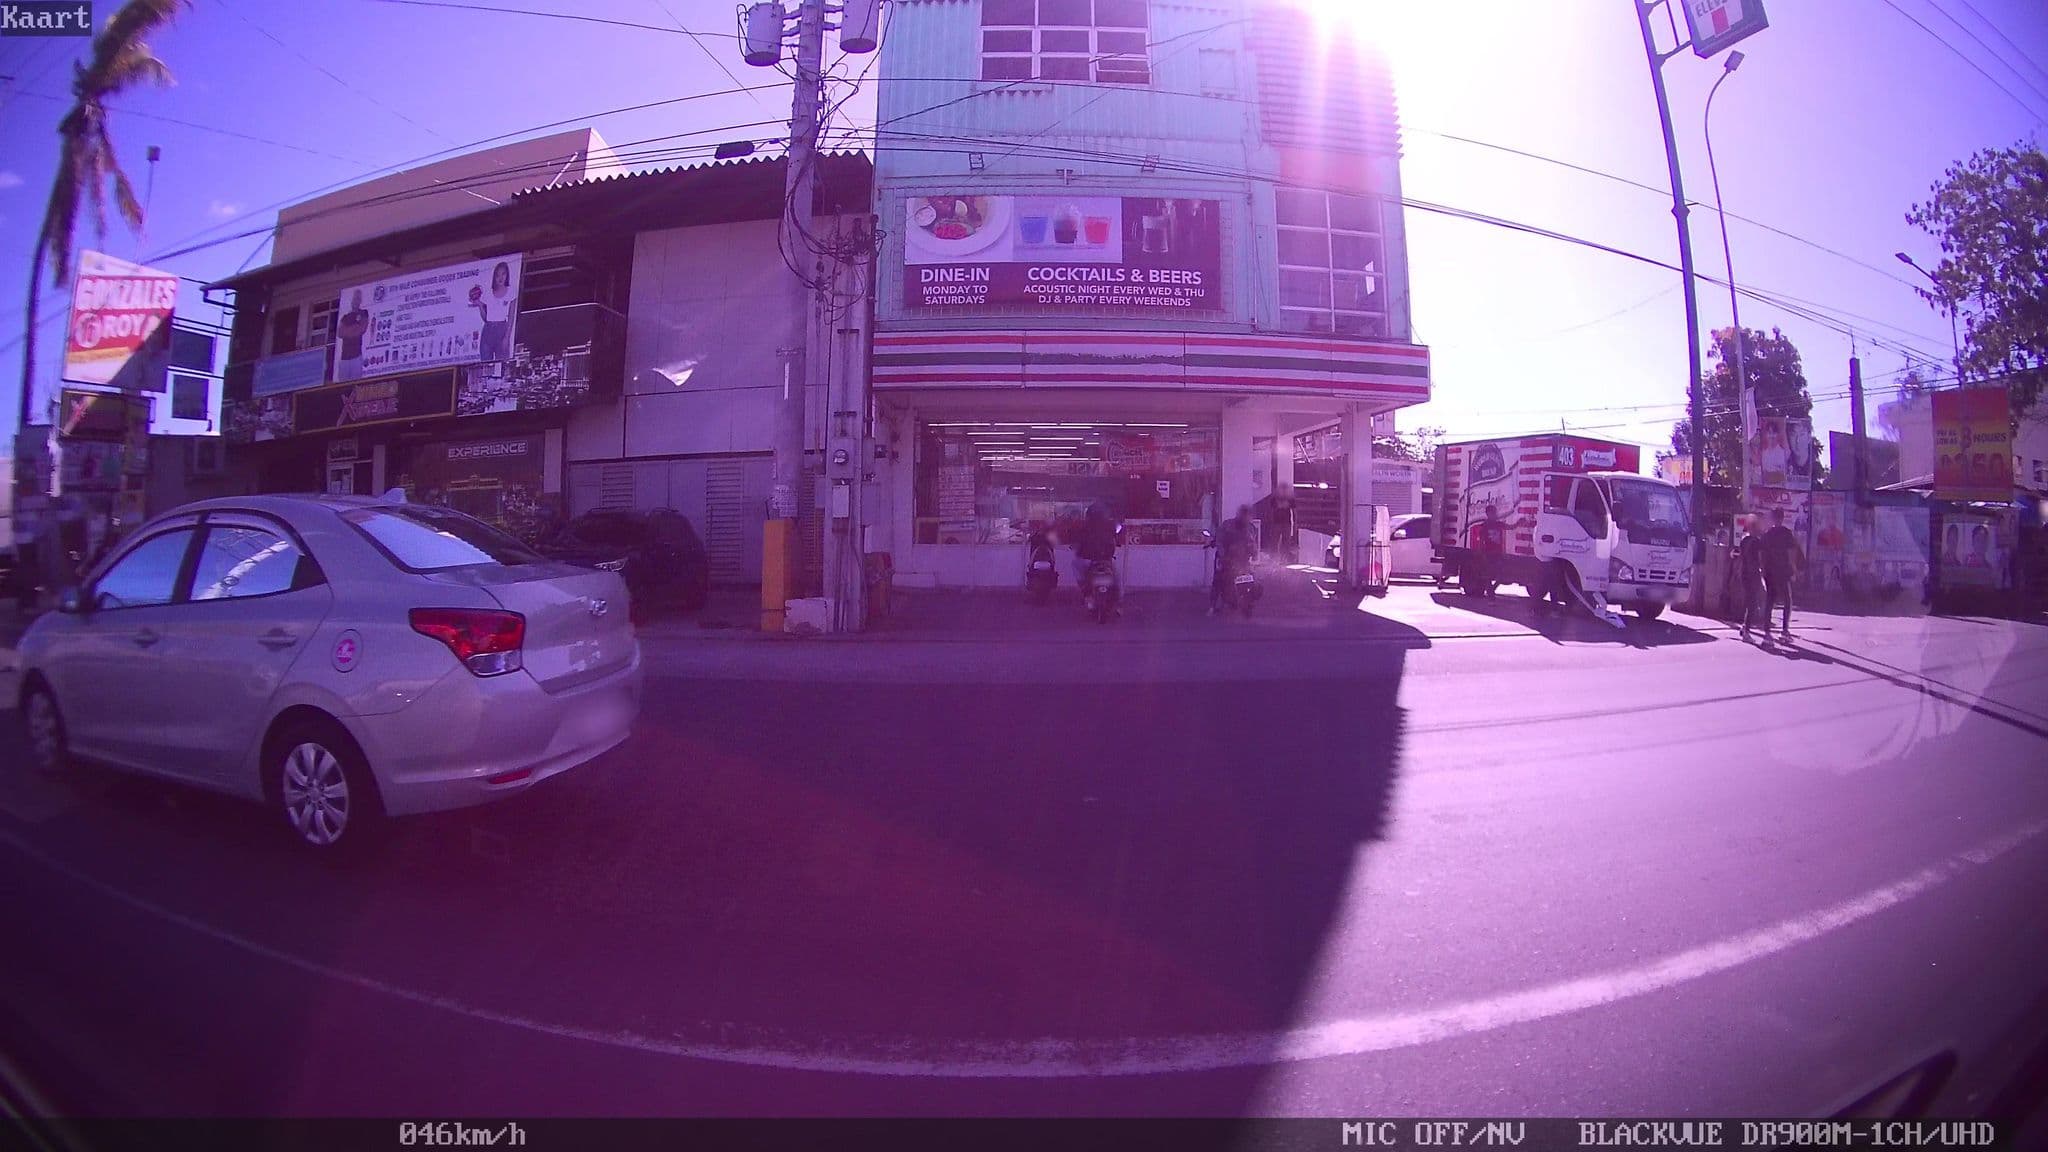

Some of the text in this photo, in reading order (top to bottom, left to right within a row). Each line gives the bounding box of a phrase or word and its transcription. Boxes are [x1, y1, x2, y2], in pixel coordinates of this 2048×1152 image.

[920, 267, 990, 283] DINE-IN
[1027, 266, 1203, 285] COCKTAILS & BEERS
[922, 284, 989, 296] MONDAY TO
[1023, 284, 1205, 298] ACOUSTIC NIGHT EVERY WED & THU
[924, 295, 986, 306] SATURDAYS
[1038, 295, 1192, 308] DJ & PARTY EVERY WEEKENDS
[447, 442, 527, 458] EXPERIENCE
[1559, 446, 1574, 466] 403
